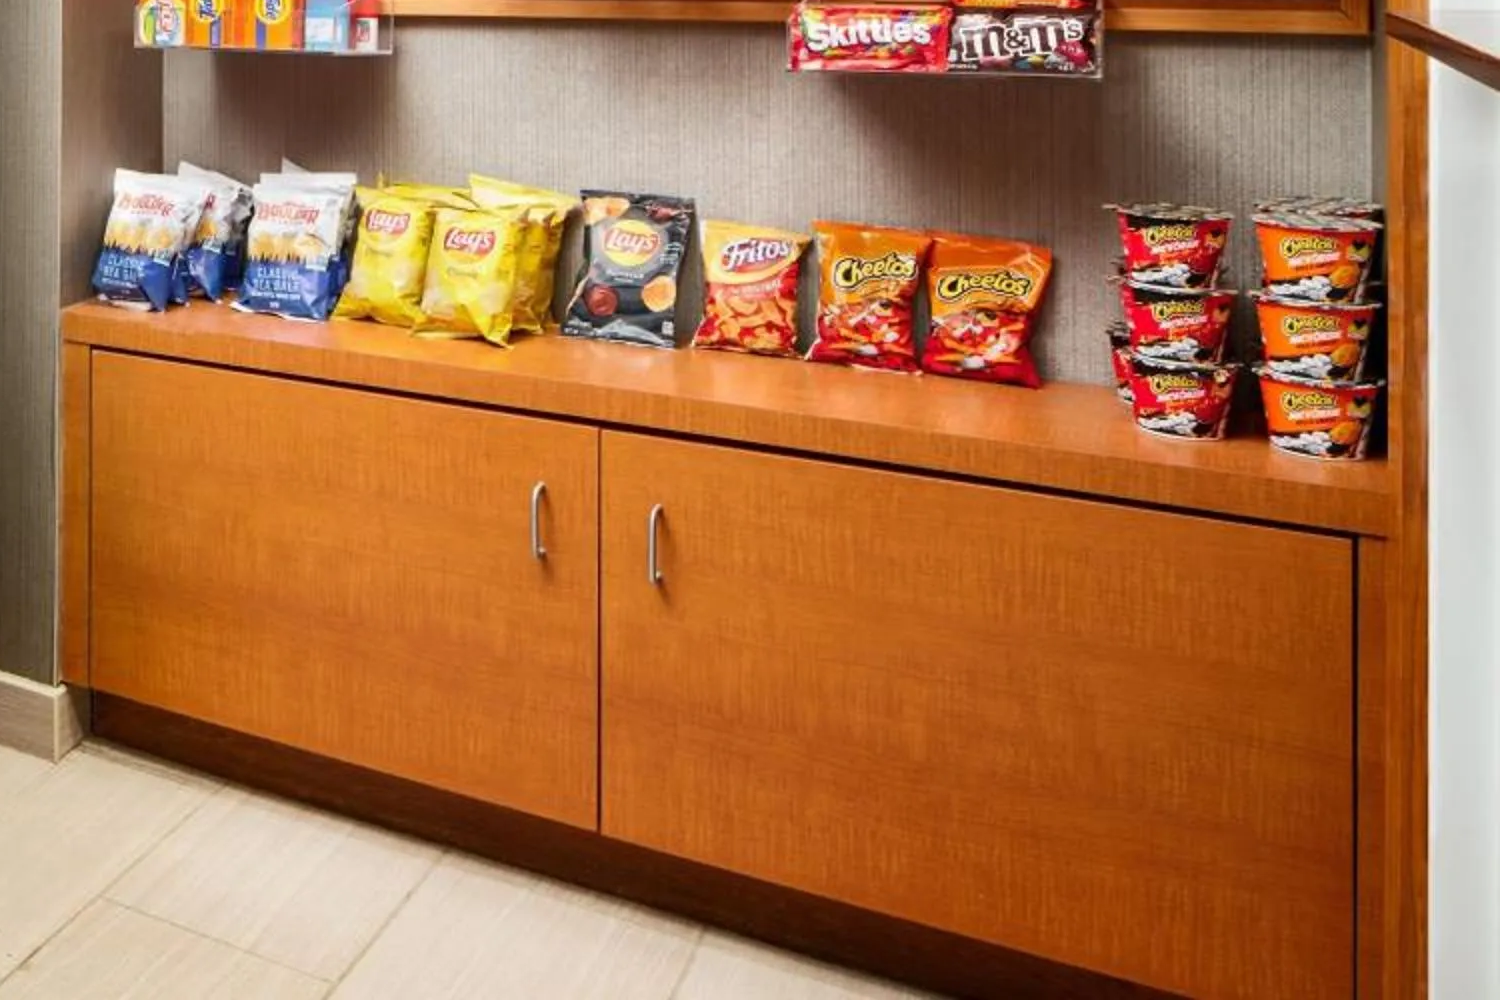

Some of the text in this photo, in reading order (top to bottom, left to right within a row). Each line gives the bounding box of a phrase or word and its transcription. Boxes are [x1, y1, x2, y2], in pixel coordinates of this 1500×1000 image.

[806, 16, 932, 52] Skittles
[726, 239, 790, 270] Fritos
[835, 252, 917, 288] Cheetos
[937, 271, 1032, 299] Cheetos
